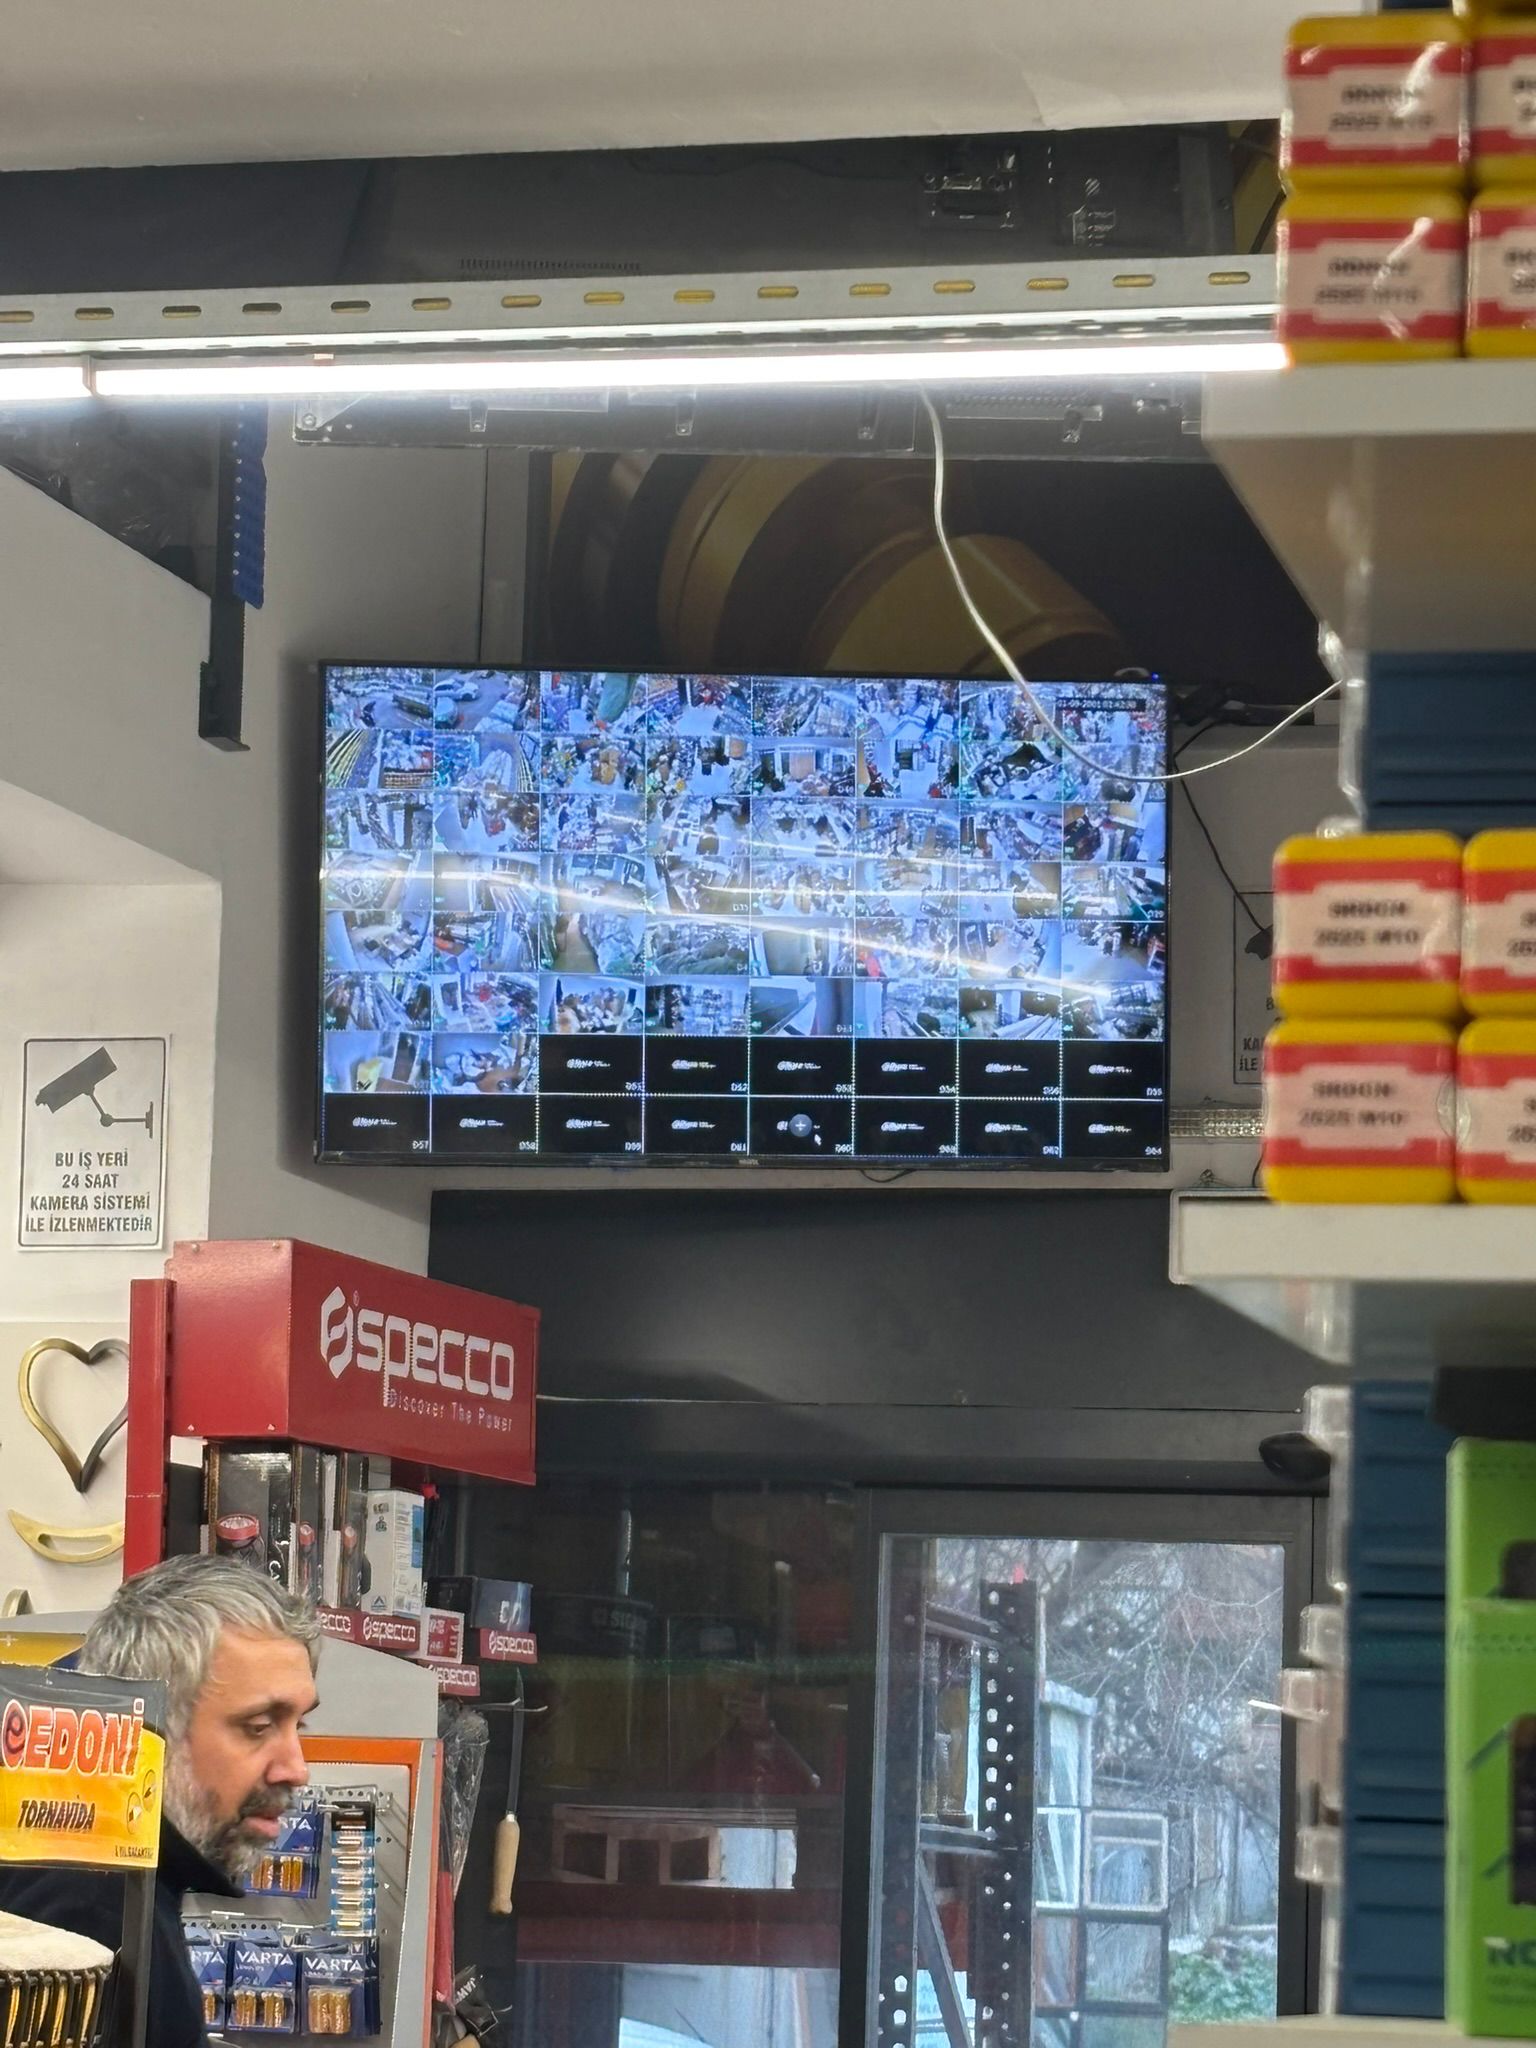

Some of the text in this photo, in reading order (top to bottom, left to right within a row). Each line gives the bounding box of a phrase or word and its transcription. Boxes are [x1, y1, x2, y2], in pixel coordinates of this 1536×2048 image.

[55, 1148, 128, 1170] BU İŞ YERİ
[62, 1174, 119, 1188] 24 SAAT
[30, 1191, 150, 1210] KAMERA SİSTEMİ
[25, 1213, 152, 1232] İLE İZLENMEKTEDİR
[356, 1308, 514, 1407] specco
[386, 1388, 513, 1432] Discover The Power
[372, 1619, 416, 1646] specco
[496, 1635, 534, 1660] specco
[190, 1950, 225, 1964] RTA
[237, 1950, 294, 1966] VARTA
[305, 1957, 363, 1972] VARTA
